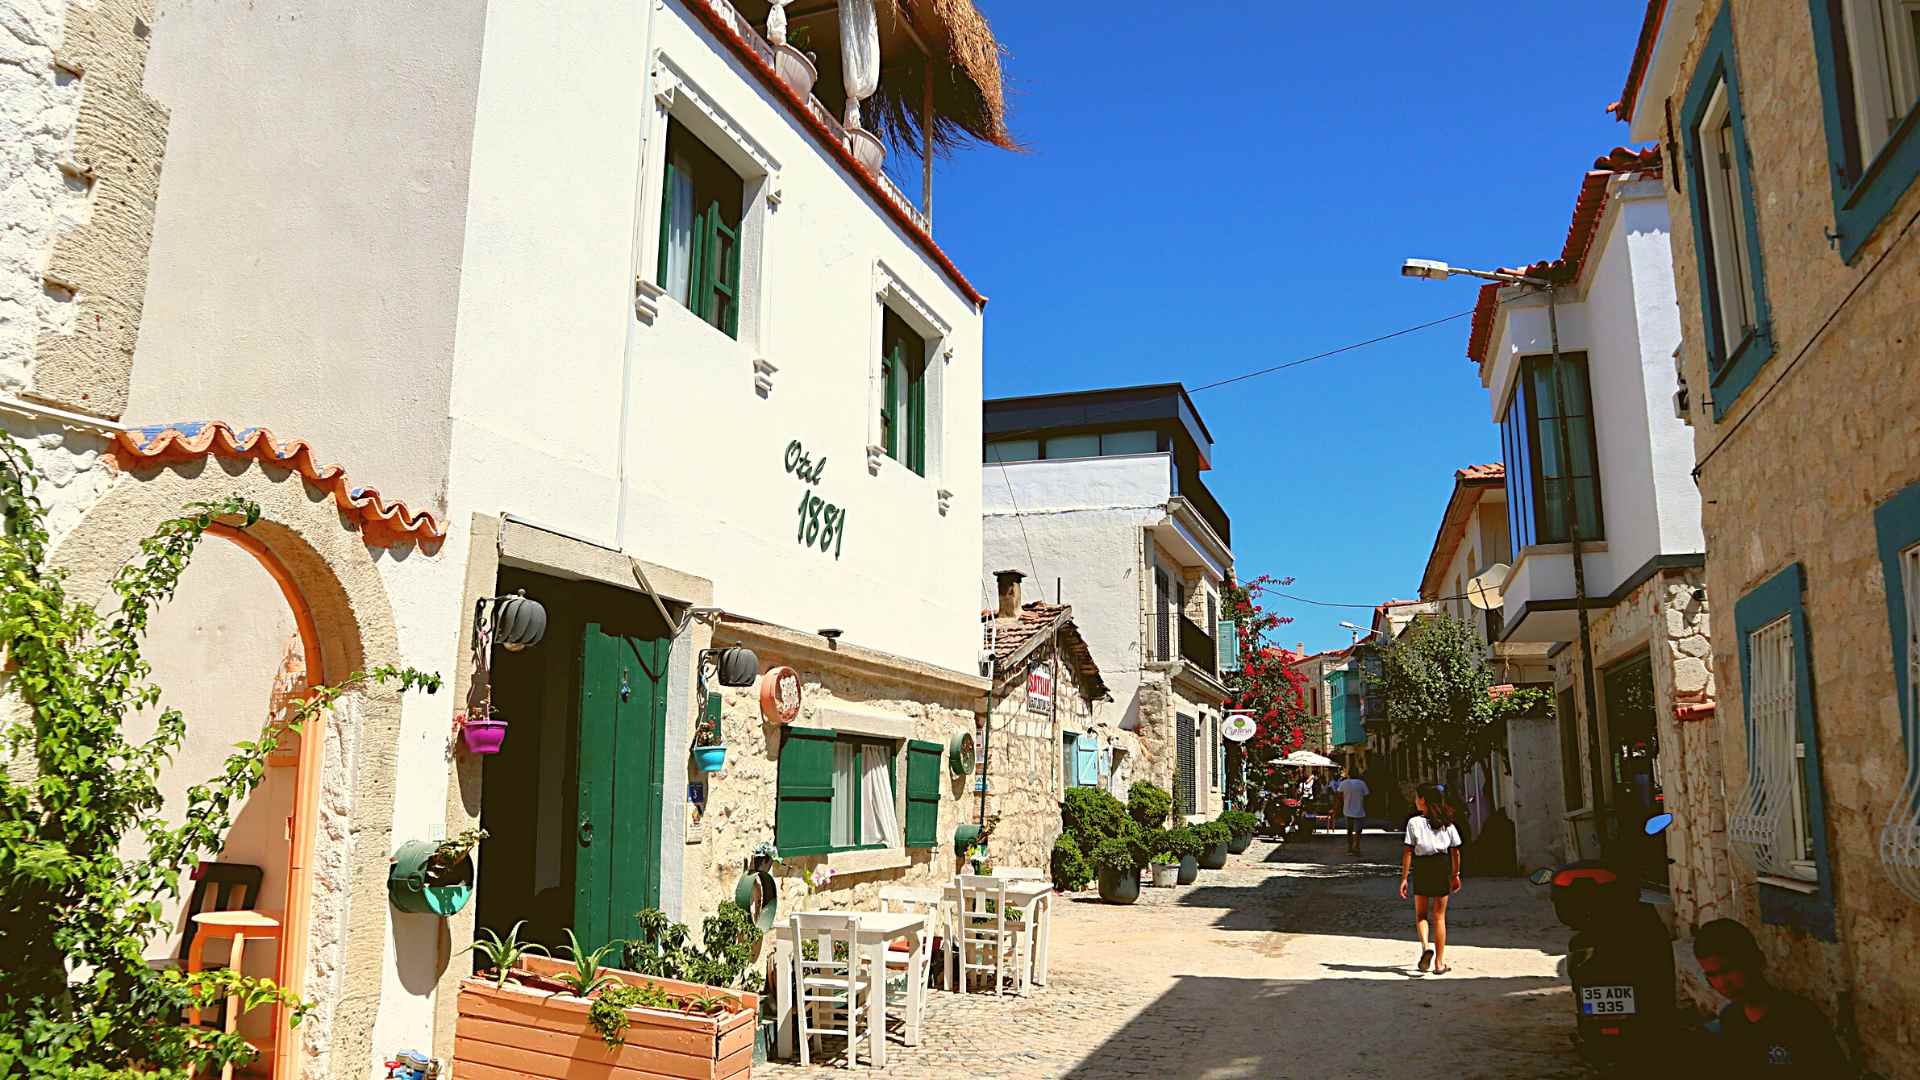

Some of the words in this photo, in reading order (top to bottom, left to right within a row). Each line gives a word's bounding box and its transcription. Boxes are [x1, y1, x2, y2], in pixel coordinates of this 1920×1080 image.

[784, 440, 826, 486] Otel
[798, 489, 845, 561] 1881
[1584, 988, 1602, 1000] 35
[1597, 1001, 1625, 1013] 935
